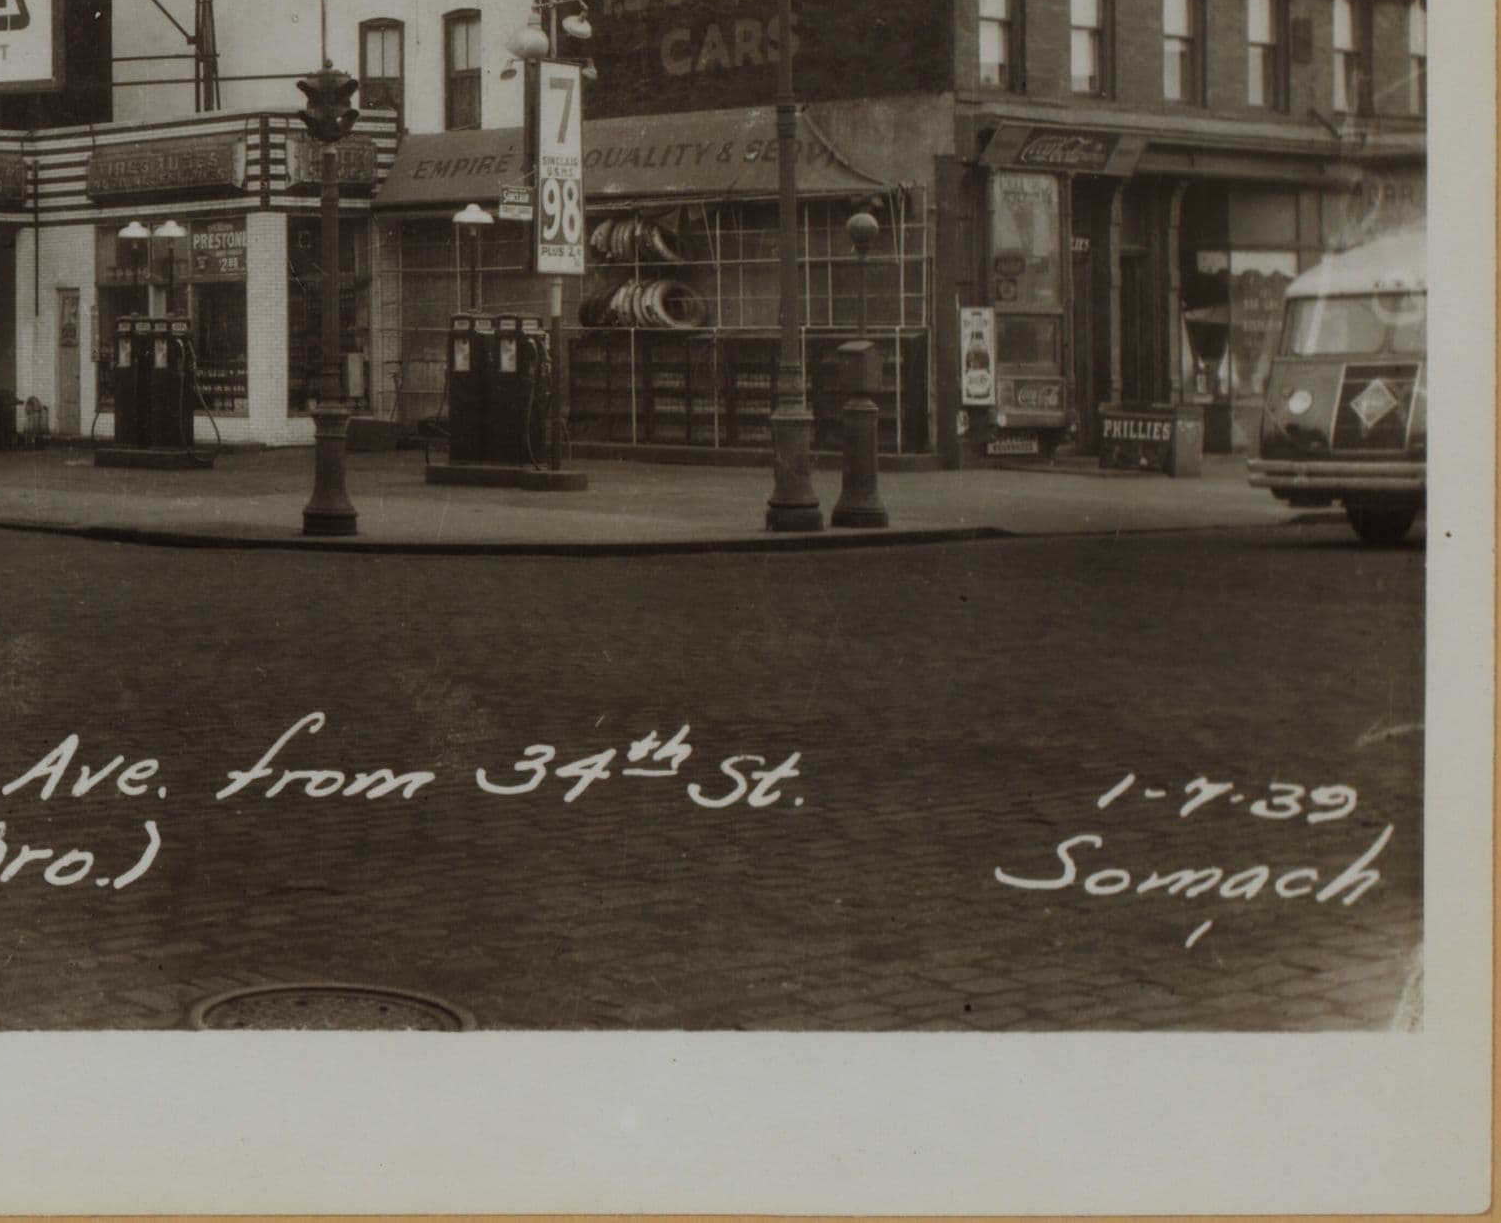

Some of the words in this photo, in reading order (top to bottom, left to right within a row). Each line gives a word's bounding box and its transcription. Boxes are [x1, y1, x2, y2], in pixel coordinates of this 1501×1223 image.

[549, 77, 574, 144] 7
[413, 153, 513, 181] EMPIRE
[583, 140, 715, 170] QUALITY
[542, 157, 579, 167] SINCLAIR
[542, 178, 582, 245] 98
[1103, 419, 1172, 441] PHILLIES
